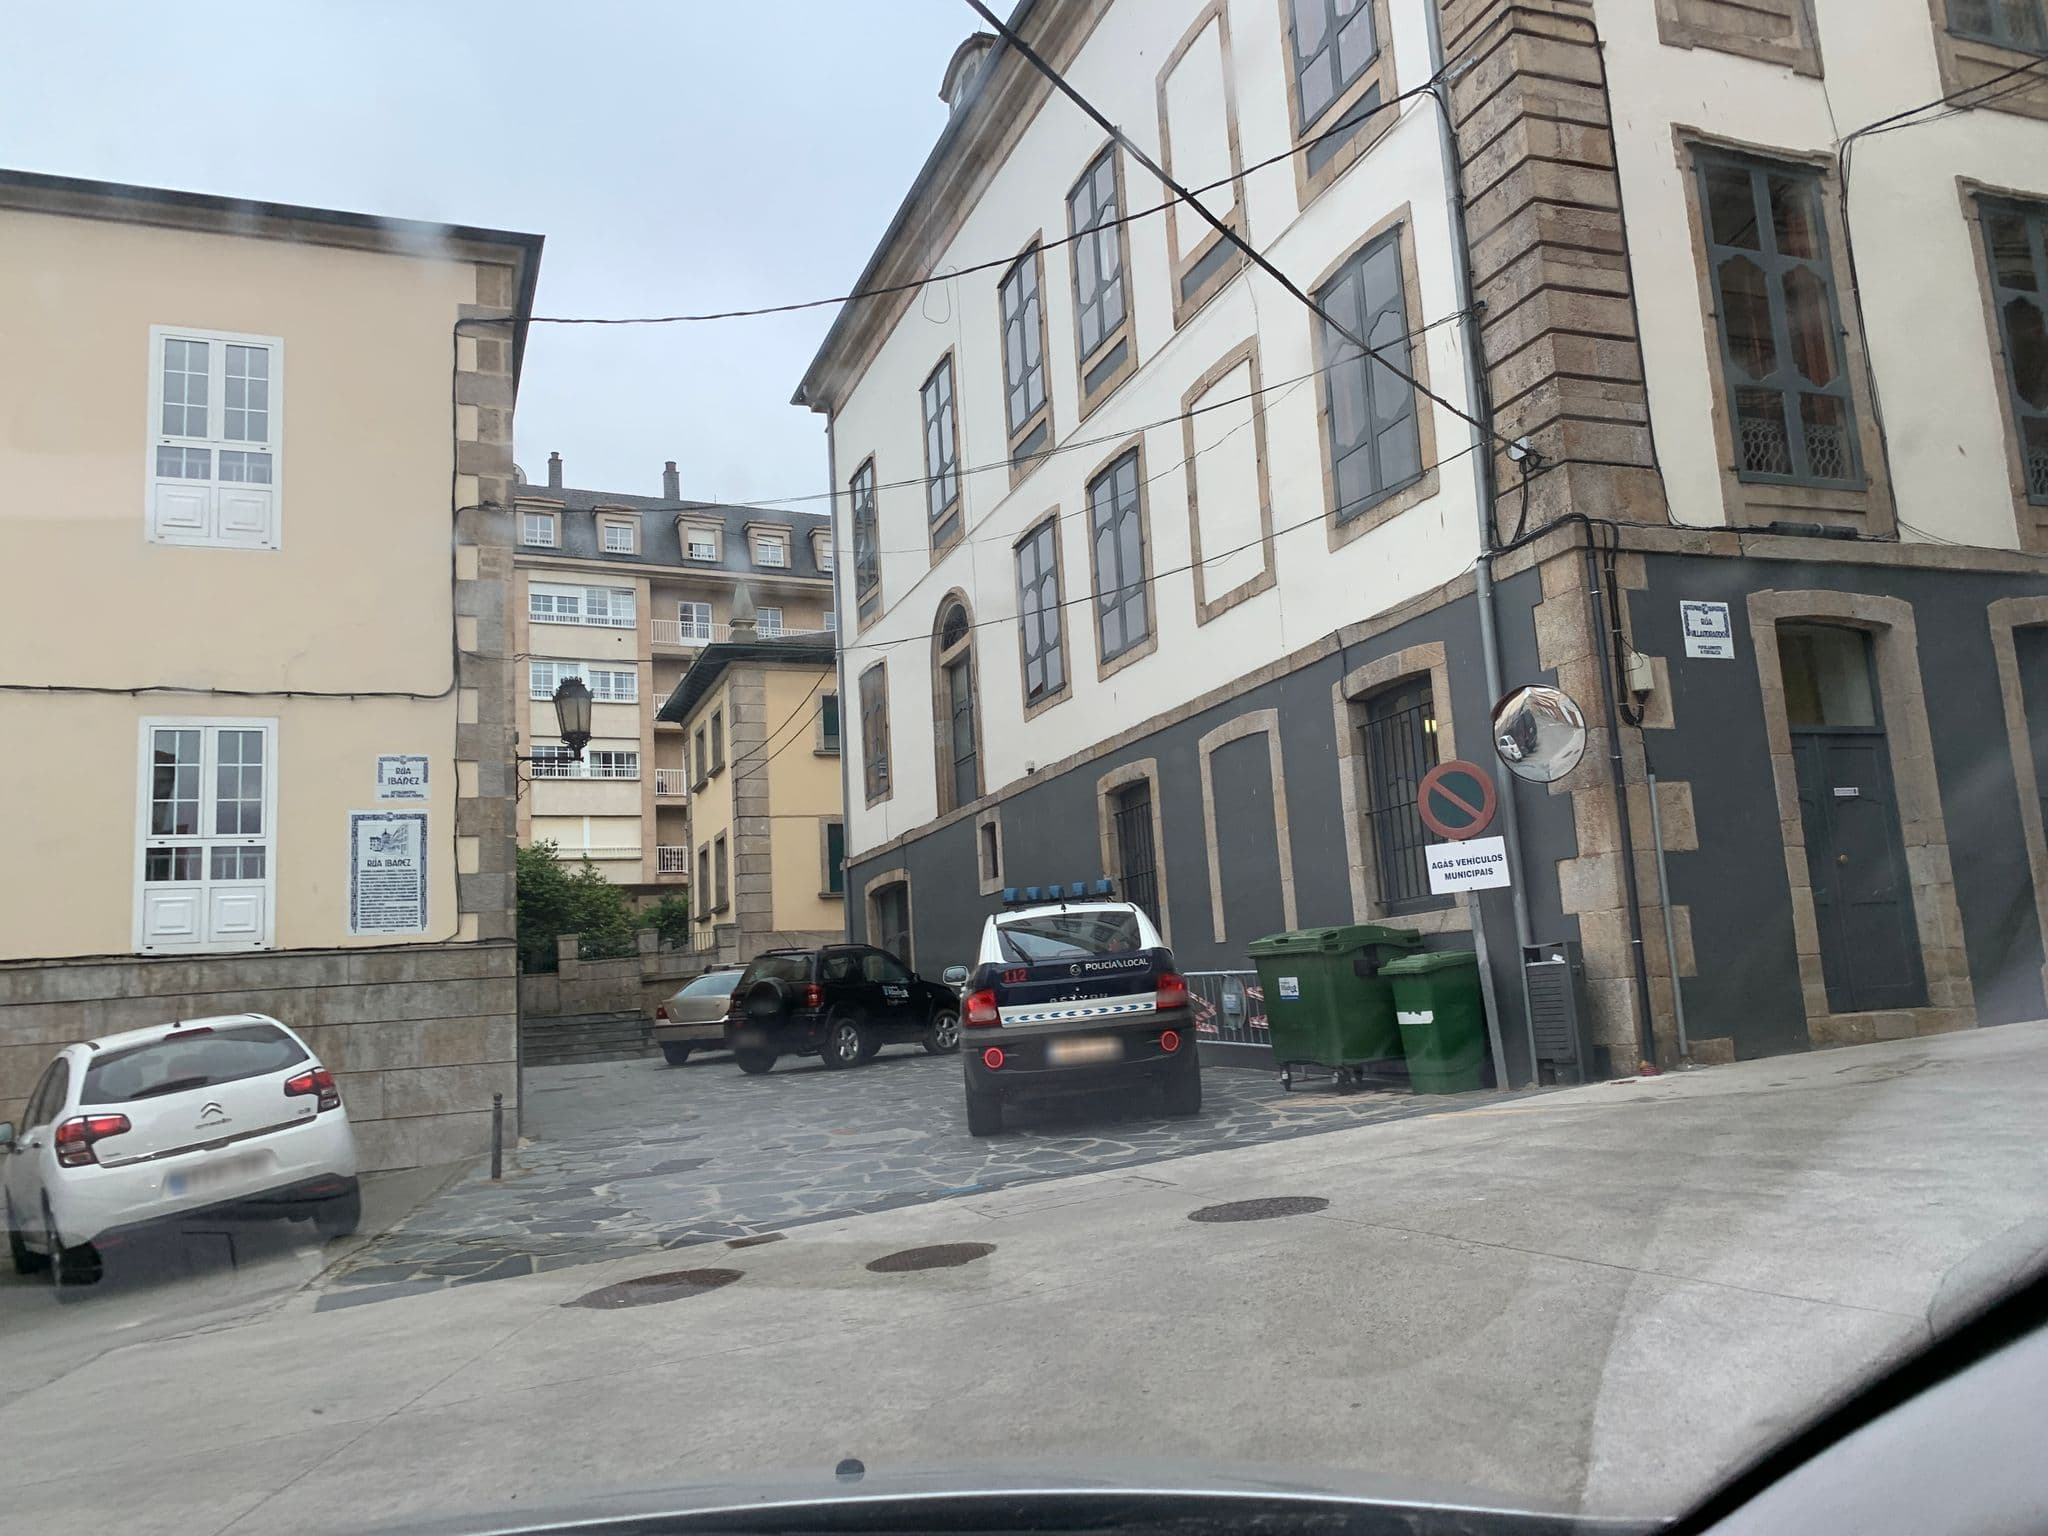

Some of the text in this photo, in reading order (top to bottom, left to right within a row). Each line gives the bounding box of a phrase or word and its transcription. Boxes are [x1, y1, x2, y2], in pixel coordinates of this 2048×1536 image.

[1444, 868, 1494, 880] MUNICIPAIS
[1123, 958, 1149, 968] LOCAL
[1003, 968, 1027, 984] 112
